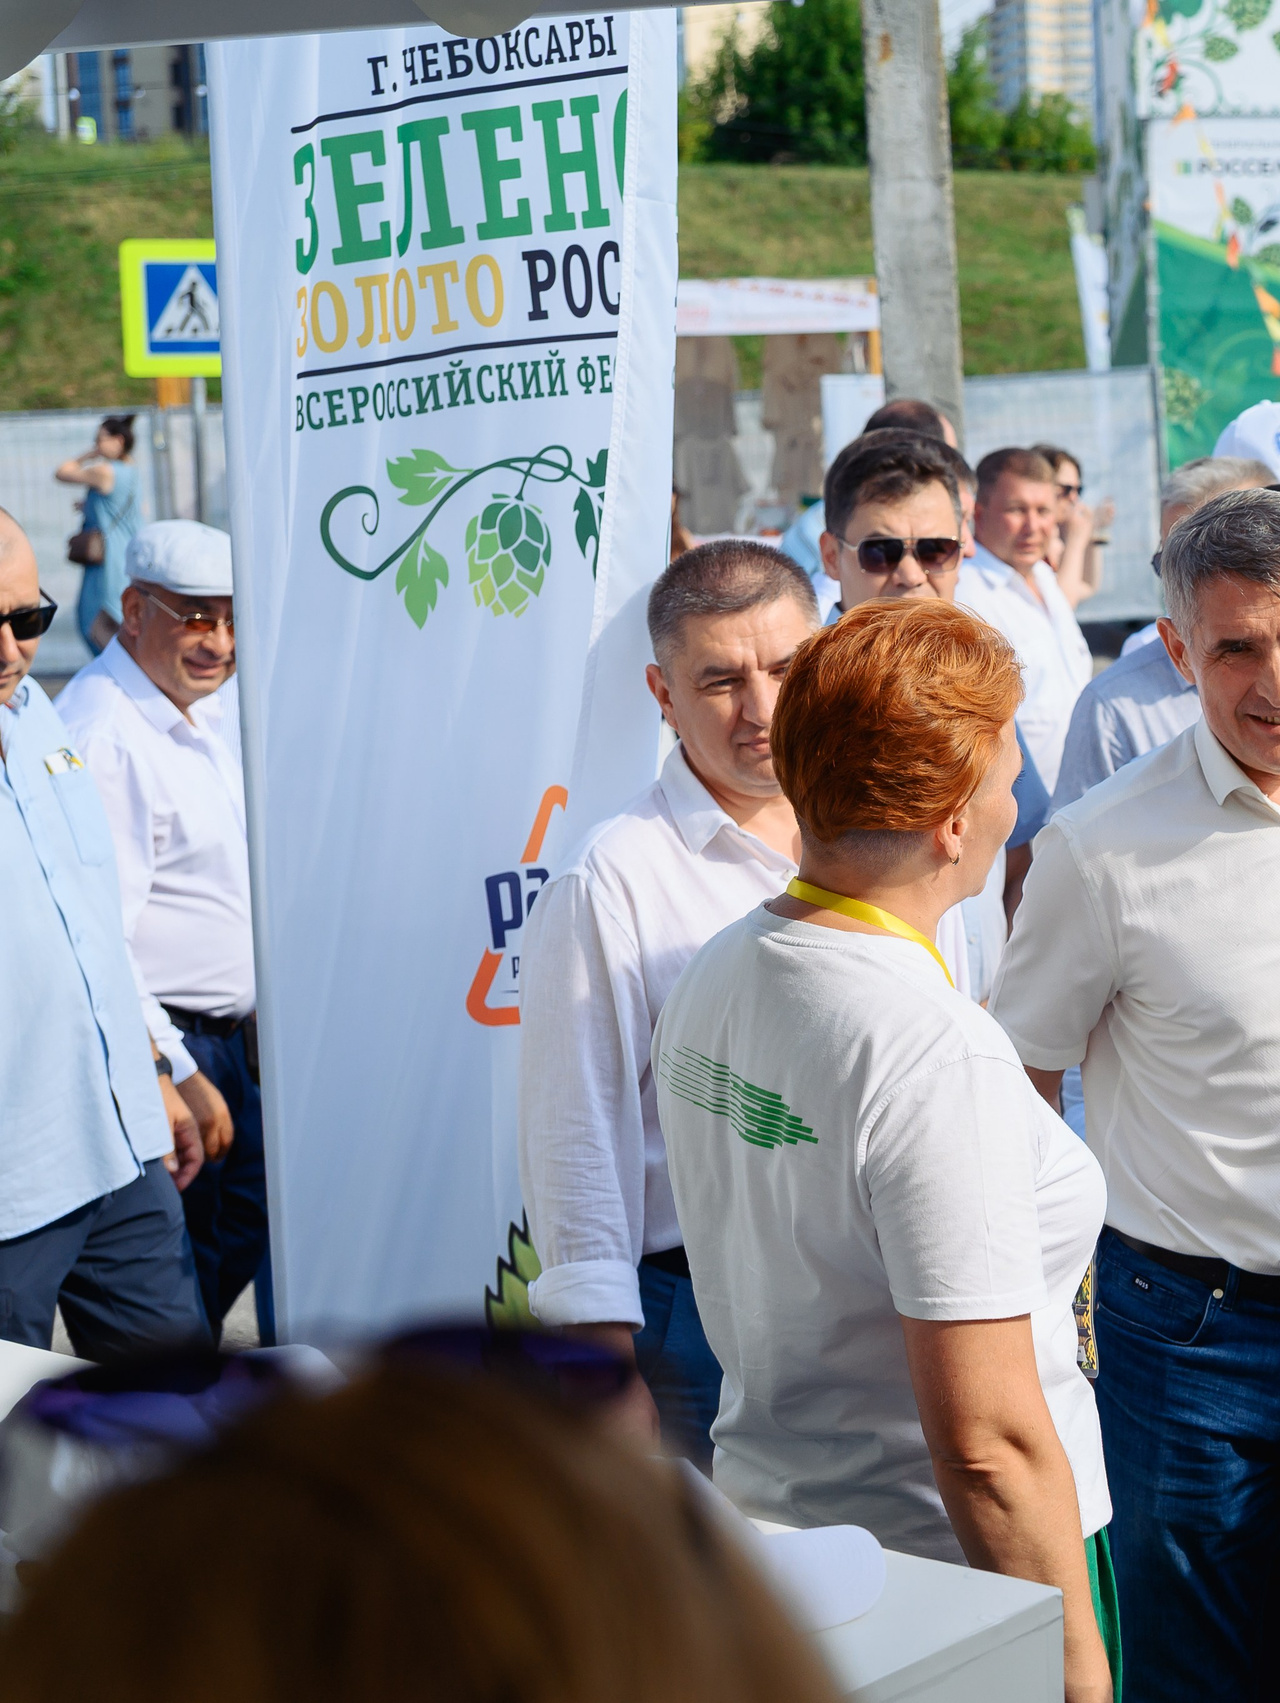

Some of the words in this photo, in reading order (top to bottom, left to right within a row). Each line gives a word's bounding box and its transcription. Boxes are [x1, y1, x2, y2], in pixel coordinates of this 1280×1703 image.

[368, 55, 398, 96] Г.
[402, 15, 617, 87] ЧЕБОКСАРЫ
[296, 254, 505, 358] ЗОЛОТО
[295, 350, 569, 432] ВСЕРОССИЙСКИЙ
[577, 354, 618, 395] ФЕ
